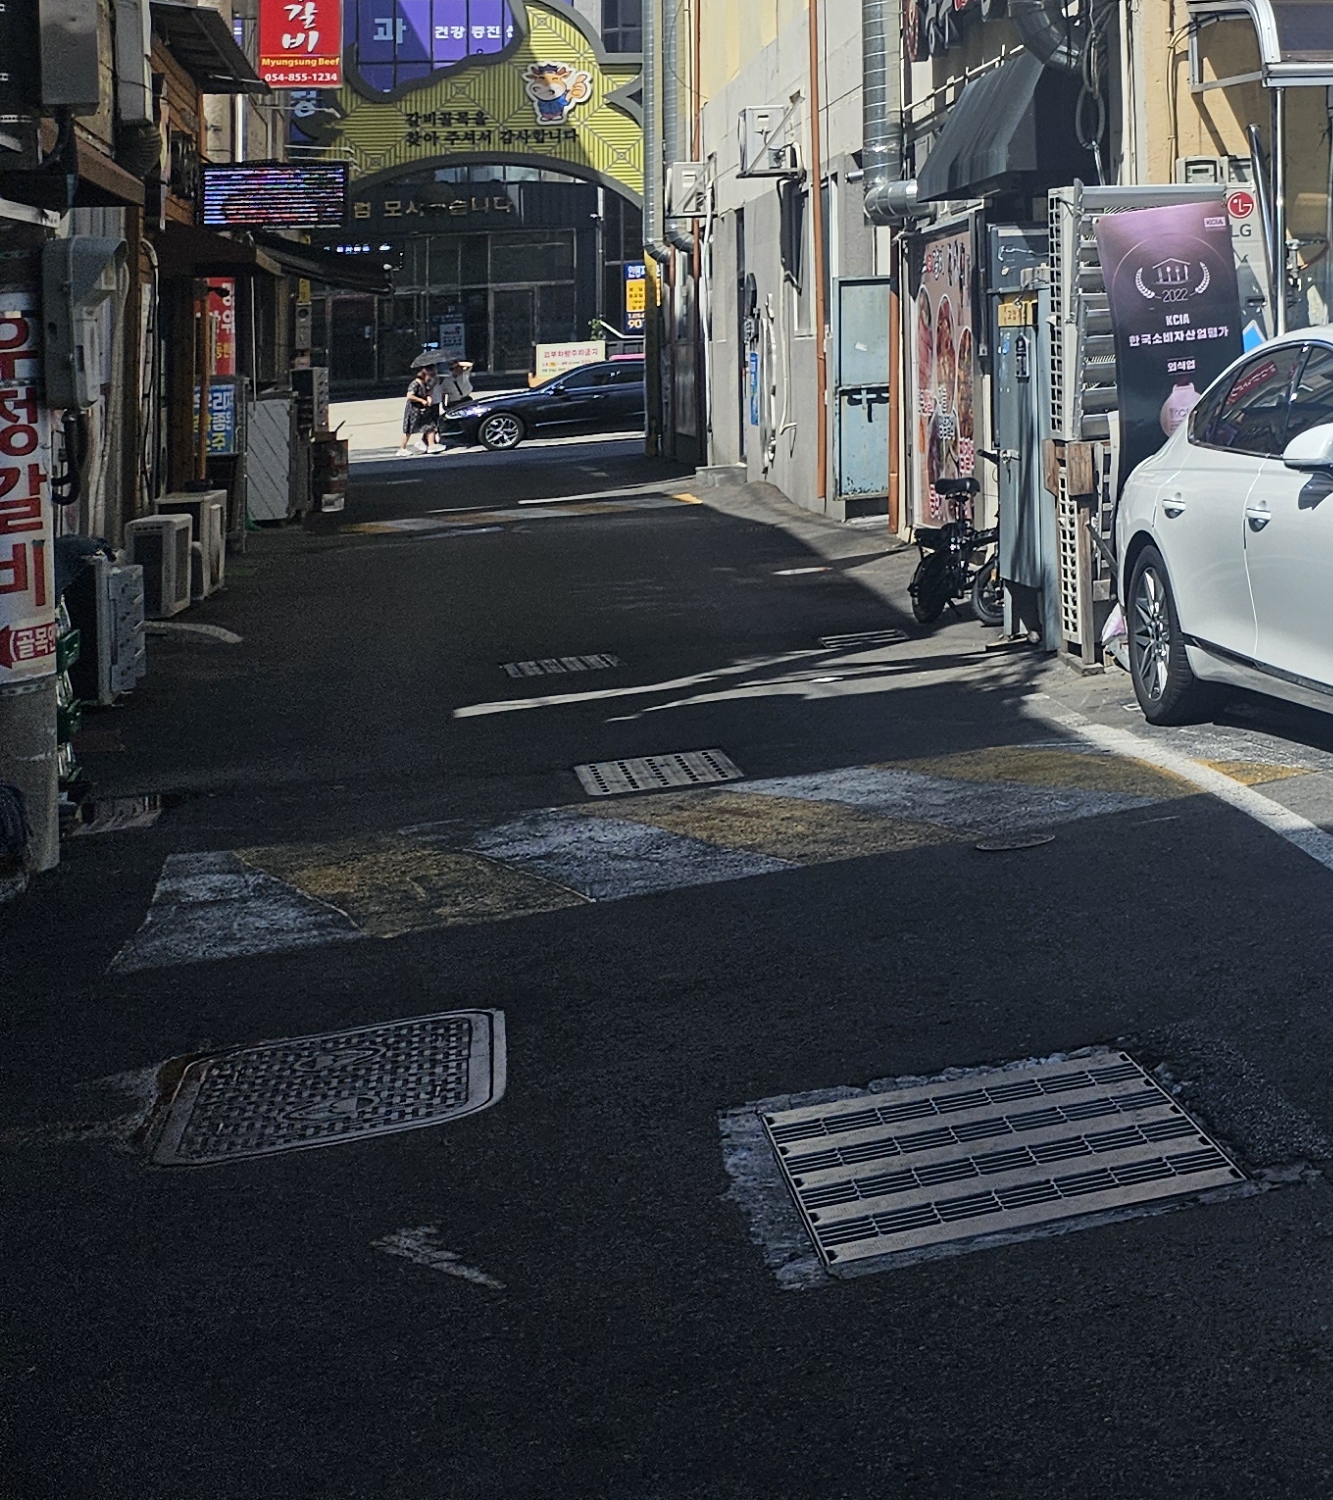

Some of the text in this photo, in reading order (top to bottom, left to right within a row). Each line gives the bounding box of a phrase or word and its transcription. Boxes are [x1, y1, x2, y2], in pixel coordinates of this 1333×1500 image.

[262, 57, 340, 68] Myungsung Beef
[264, 72, 338, 82] 054-855-1234
[499, 128, 579, 145] 감사합니다
[1162, 289, 1188, 302] 2022
[1165, 314, 1190, 326] KCIA
